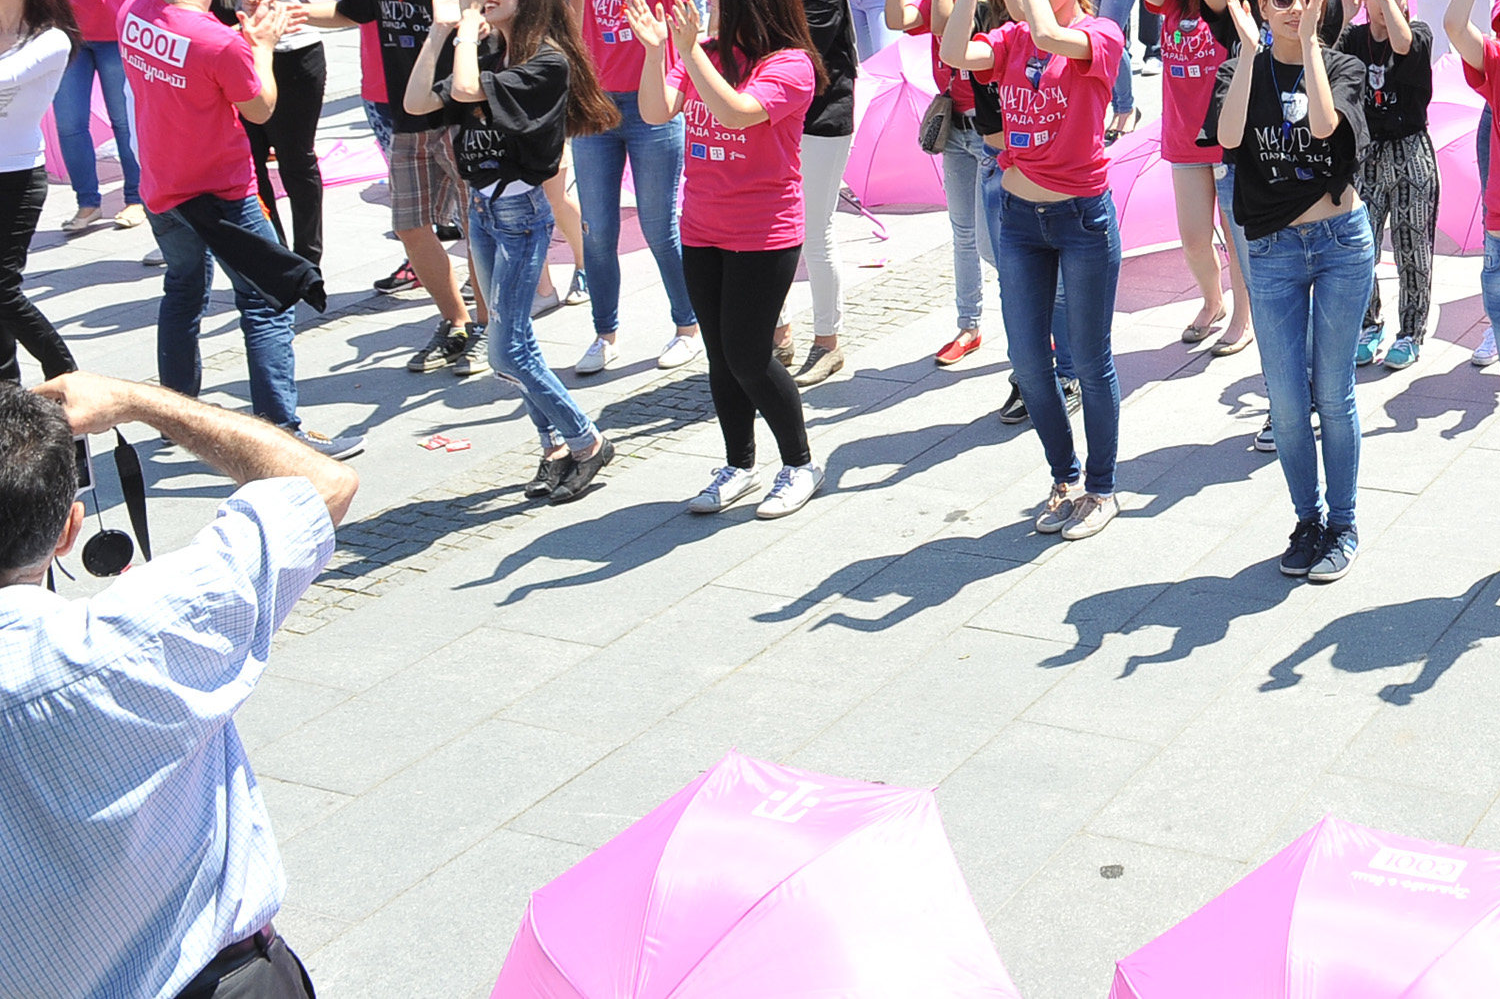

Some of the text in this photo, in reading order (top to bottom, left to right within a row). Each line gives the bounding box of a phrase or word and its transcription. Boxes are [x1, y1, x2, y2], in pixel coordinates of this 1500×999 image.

[126, 20, 181, 63] COOL
[1005, 112, 1035, 126] РАДА
[714, 132, 747, 144] 2014
